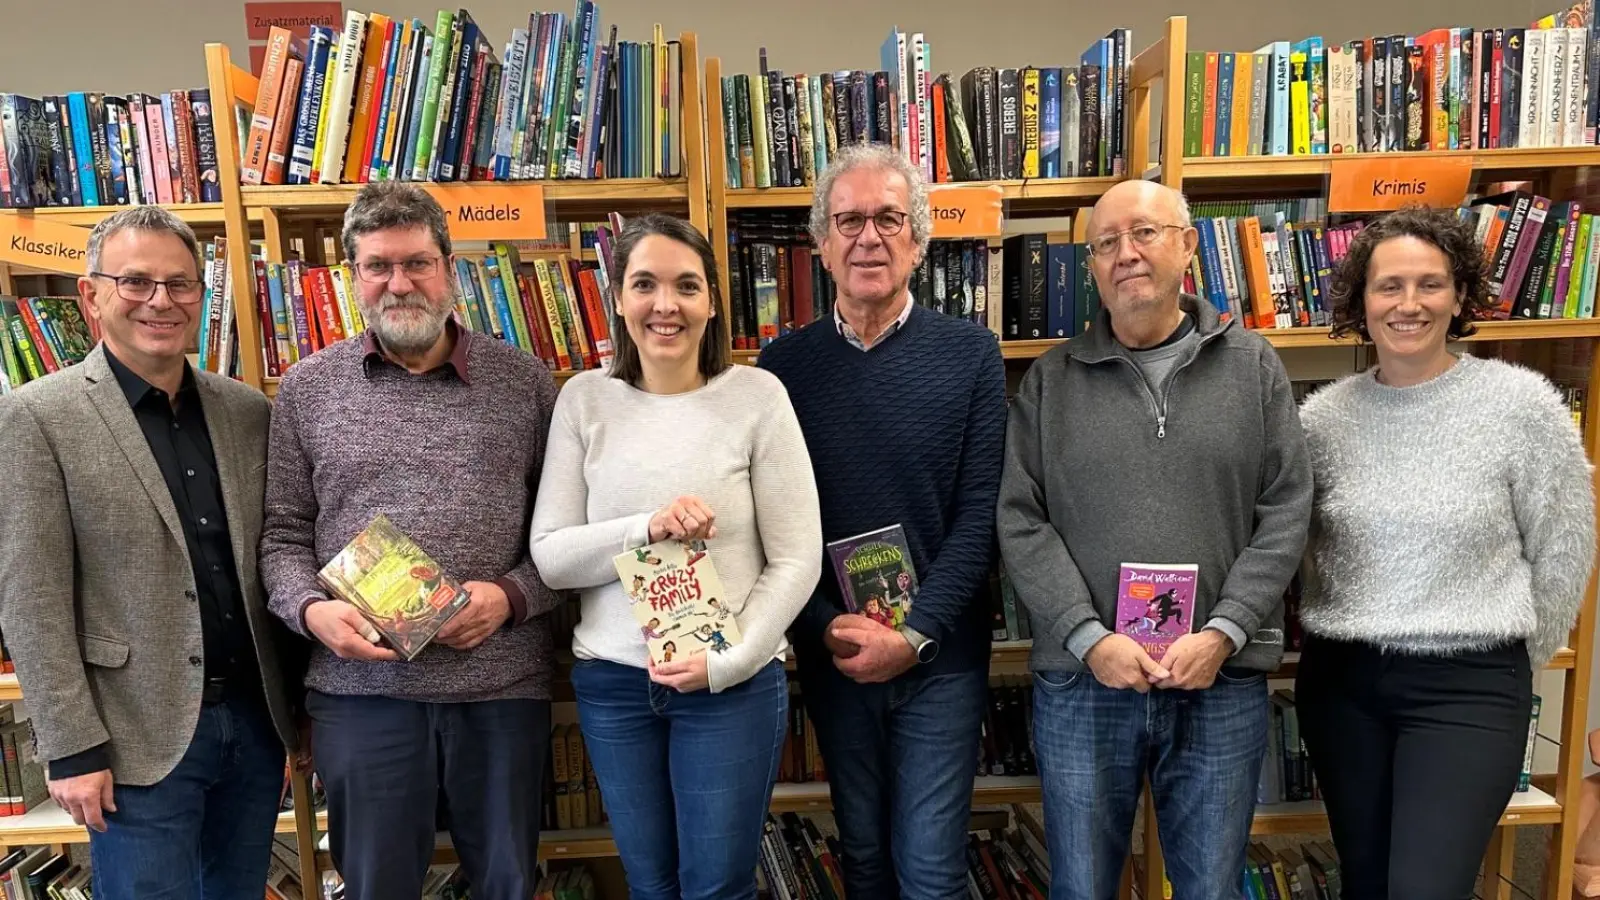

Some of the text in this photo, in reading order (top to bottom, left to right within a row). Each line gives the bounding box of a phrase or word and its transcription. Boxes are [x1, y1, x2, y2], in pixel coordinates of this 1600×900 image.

[254, 15, 333, 27] Zusatzmaterial
[343, 42, 356, 74] Trucks
[460, 43, 470, 68] QUIZ
[1278, 54, 1286, 91] KRABAT
[1551, 55, 1562, 122] KRONENHERZ
[1569, 54, 1579, 122] KRONENTRAUM
[1527, 56, 1538, 124] KRONENNACHT
[836, 88, 847, 146] ALCON PEAK
[917, 68, 926, 147] TRAKTOR TOTAL
[1003, 97, 1015, 134] EREBOS
[151, 117, 163, 153] WUNDER
[197, 126, 209, 161] LOST
[296, 128, 305, 143] DAS
[771, 106, 788, 153] MOMO
[1372, 178, 1427, 196] Krimis
[458, 203, 520, 222] Mädels
[930, 207, 966, 223] tasy
[1509, 196, 1529, 231] SAWYER
[11, 235, 85, 260] Klassiker
[1503, 230, 1517, 249] TOM
[1537, 230, 1554, 260] Mühle
[1494, 264, 1505, 279] Mark
[210, 257, 224, 319] DINOSAURIER
[542, 283, 560, 328] ANASTASIA
[844, 546, 902, 573] SCHRECKENS
[650, 566, 696, 595] CRAZY
[1124, 570, 1194, 583] David Walliams
